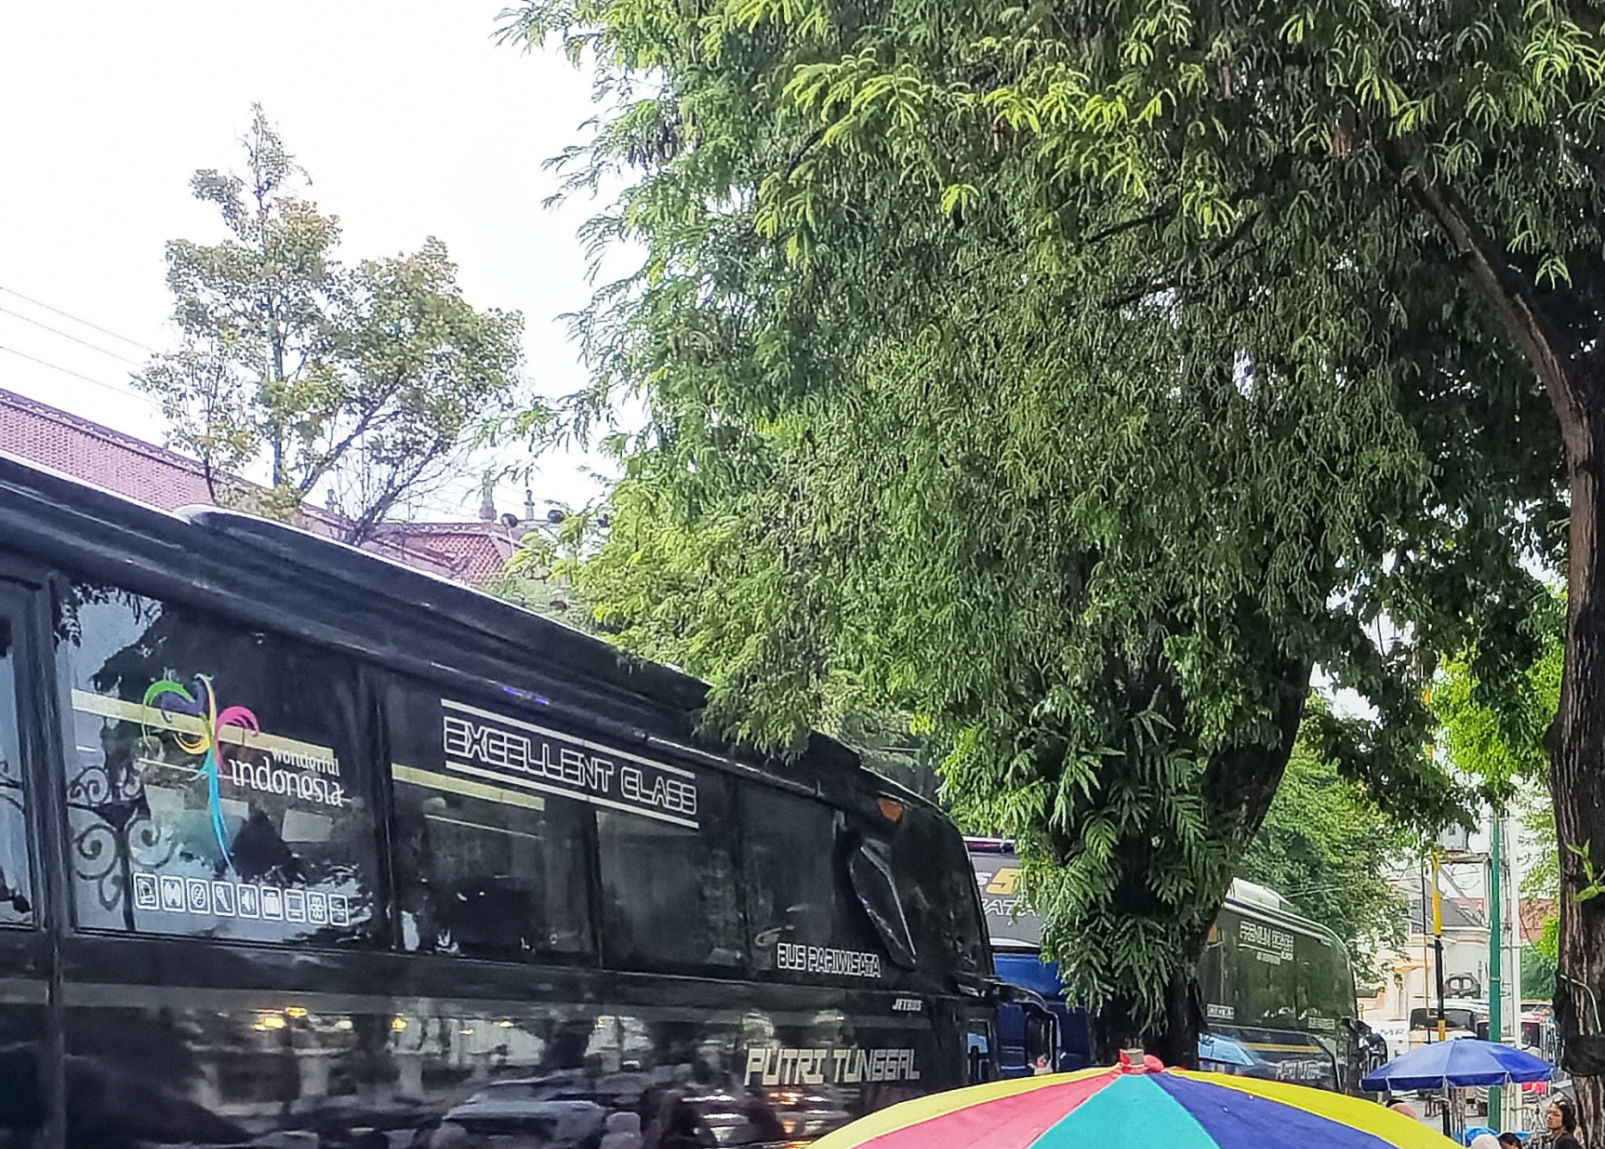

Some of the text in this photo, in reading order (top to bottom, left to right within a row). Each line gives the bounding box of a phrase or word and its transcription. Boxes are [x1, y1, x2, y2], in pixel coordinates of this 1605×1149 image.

[271, 748, 340, 776] wonderful
[443, 715, 697, 815] EXCELLENT CLASS
[229, 757, 345, 807] indonesia
[777, 942, 882, 979] BUS PARIWISATA
[744, 1048, 921, 1087] PUTRI TUNGGAL
